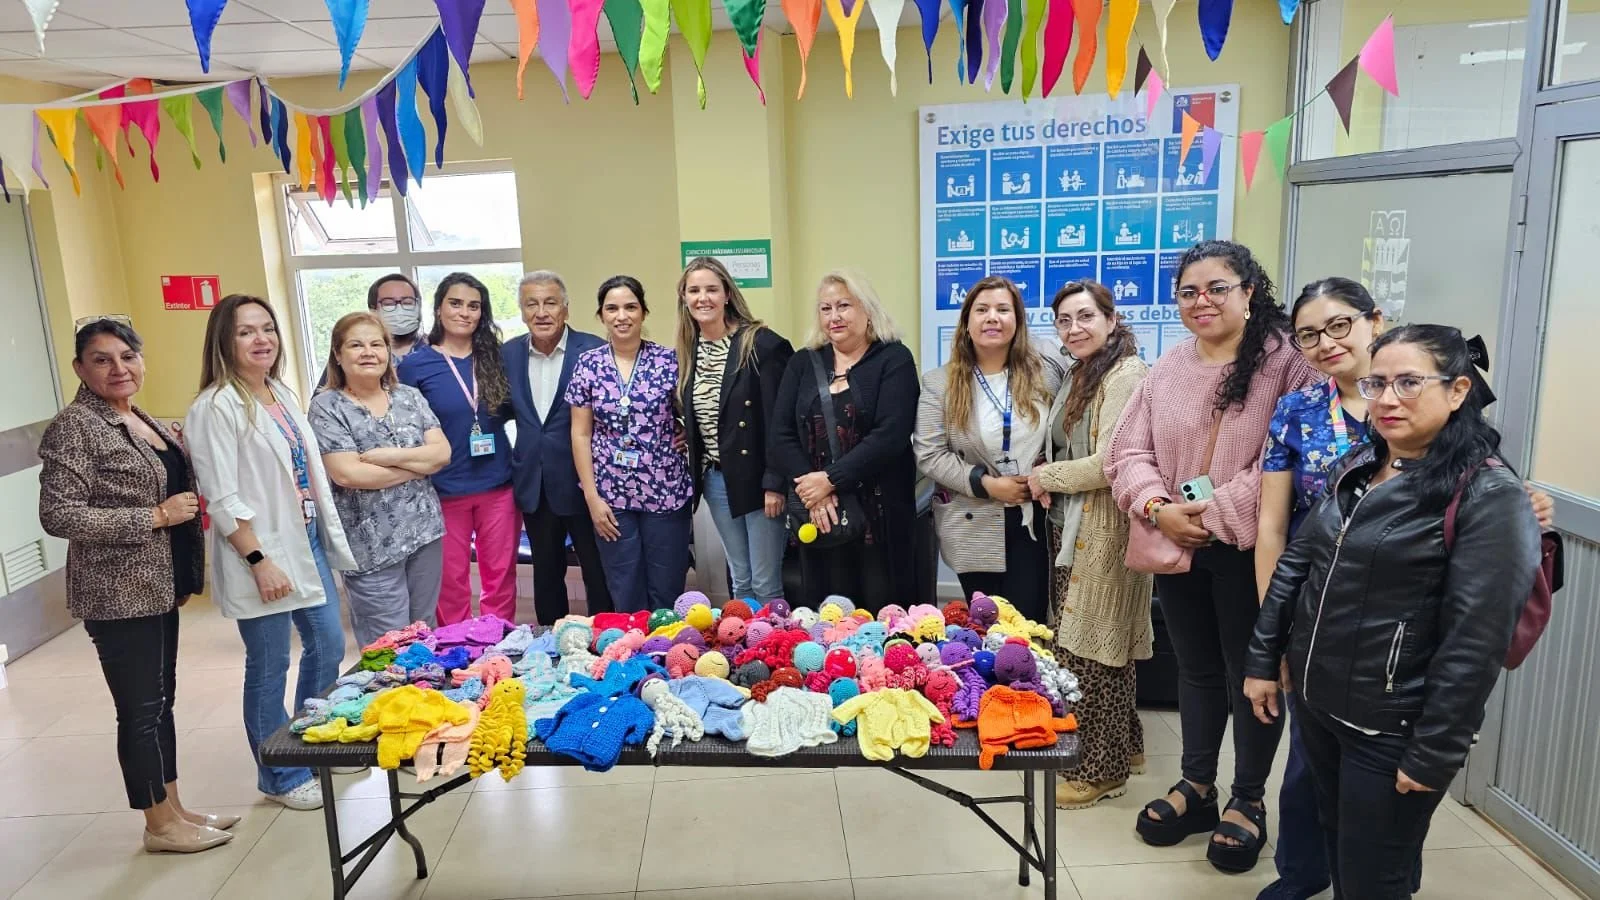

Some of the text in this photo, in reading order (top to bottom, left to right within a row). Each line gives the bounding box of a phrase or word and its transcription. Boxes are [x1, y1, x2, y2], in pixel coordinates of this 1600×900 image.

[937, 114, 1147, 148] Exige tus derechos
[165, 302, 191, 310] Extintor
[1140, 306, 1180, 321] debe
